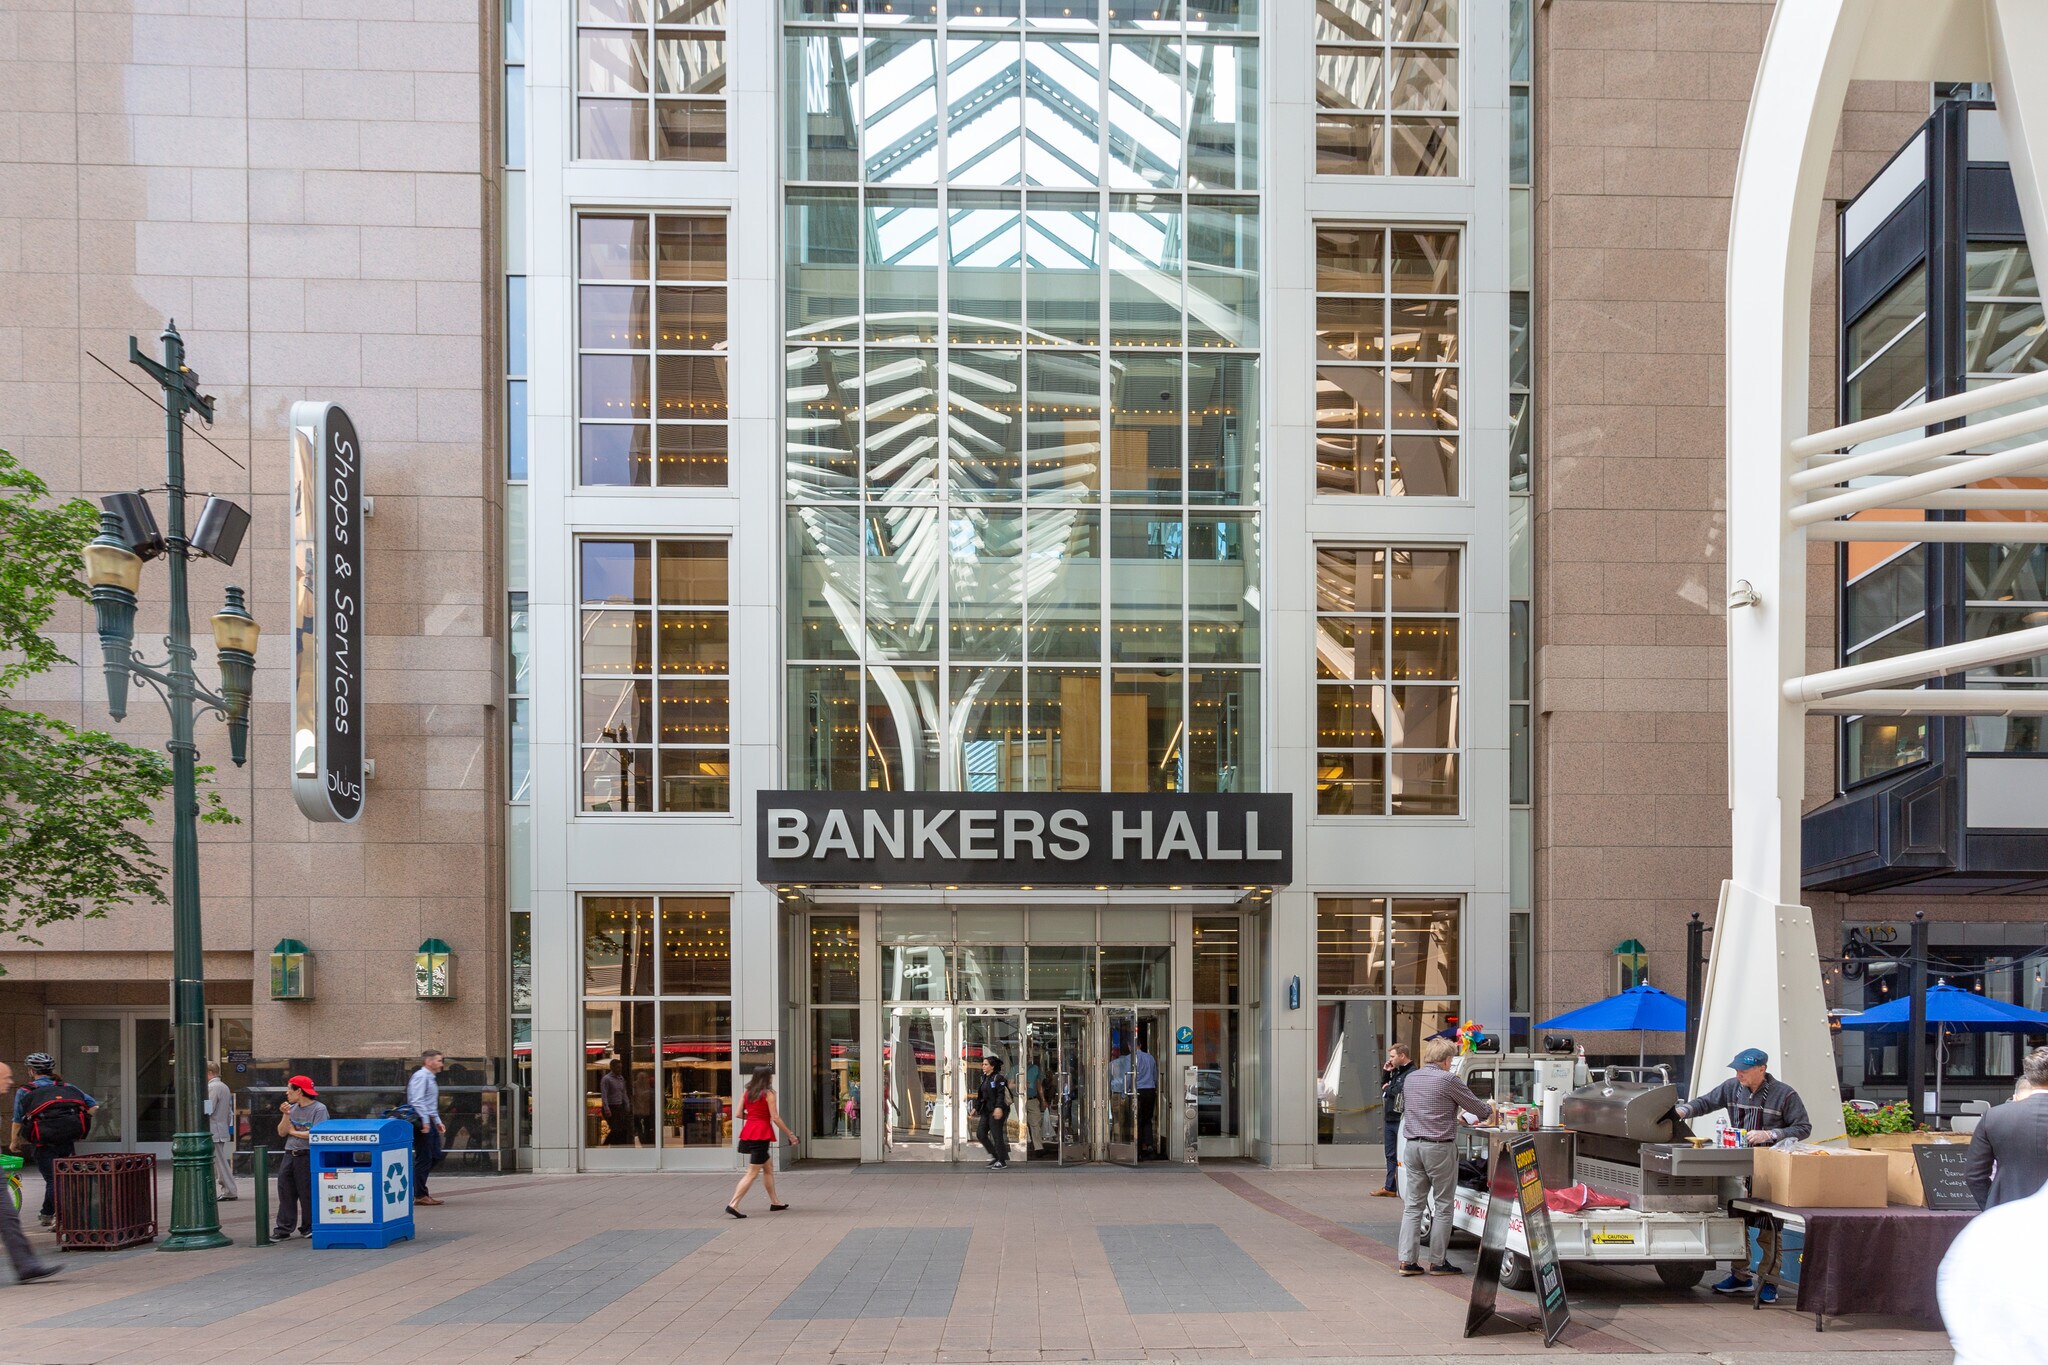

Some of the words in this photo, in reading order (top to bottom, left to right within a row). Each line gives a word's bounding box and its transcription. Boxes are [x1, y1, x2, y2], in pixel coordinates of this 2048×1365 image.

[330, 431, 354, 545] Shops
[335, 554, 352, 580] &
[334, 588, 354, 735] Services
[767, 808, 1091, 861] BANKERS
[1110, 810, 1284, 861] HALL
[903, 963, 933, 979] 315
[321, 1134, 350, 1142] RECYCLE
[350, 1134, 368, 1142] HERE
